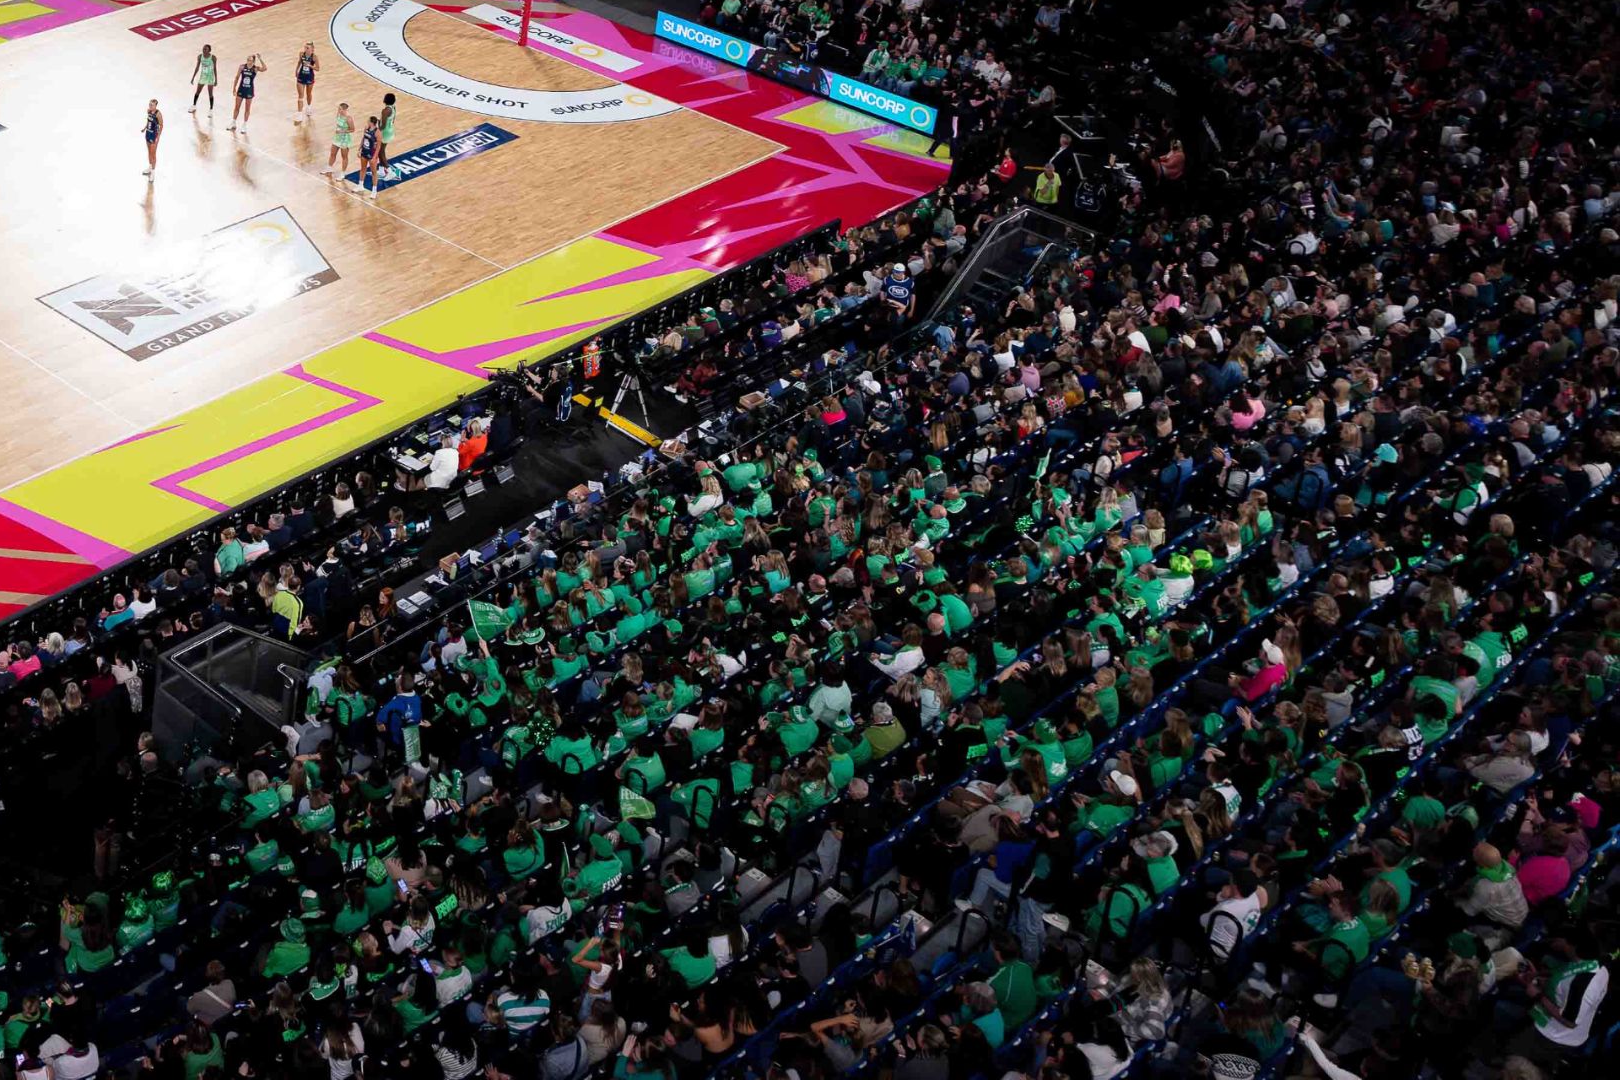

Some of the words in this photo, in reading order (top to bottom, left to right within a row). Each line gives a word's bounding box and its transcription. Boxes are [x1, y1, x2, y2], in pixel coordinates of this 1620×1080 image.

[663, 20, 721, 49] SUNCORP
[362, 40, 415, 77] SUNCORP
[413, 76, 470, 99] SUPER
[473, 94, 529, 109] SHOT
[551, 98, 624, 115] SUNCORP
[839, 83, 906, 115] SUNCORP
[147, 321, 214, 353] GRAND
